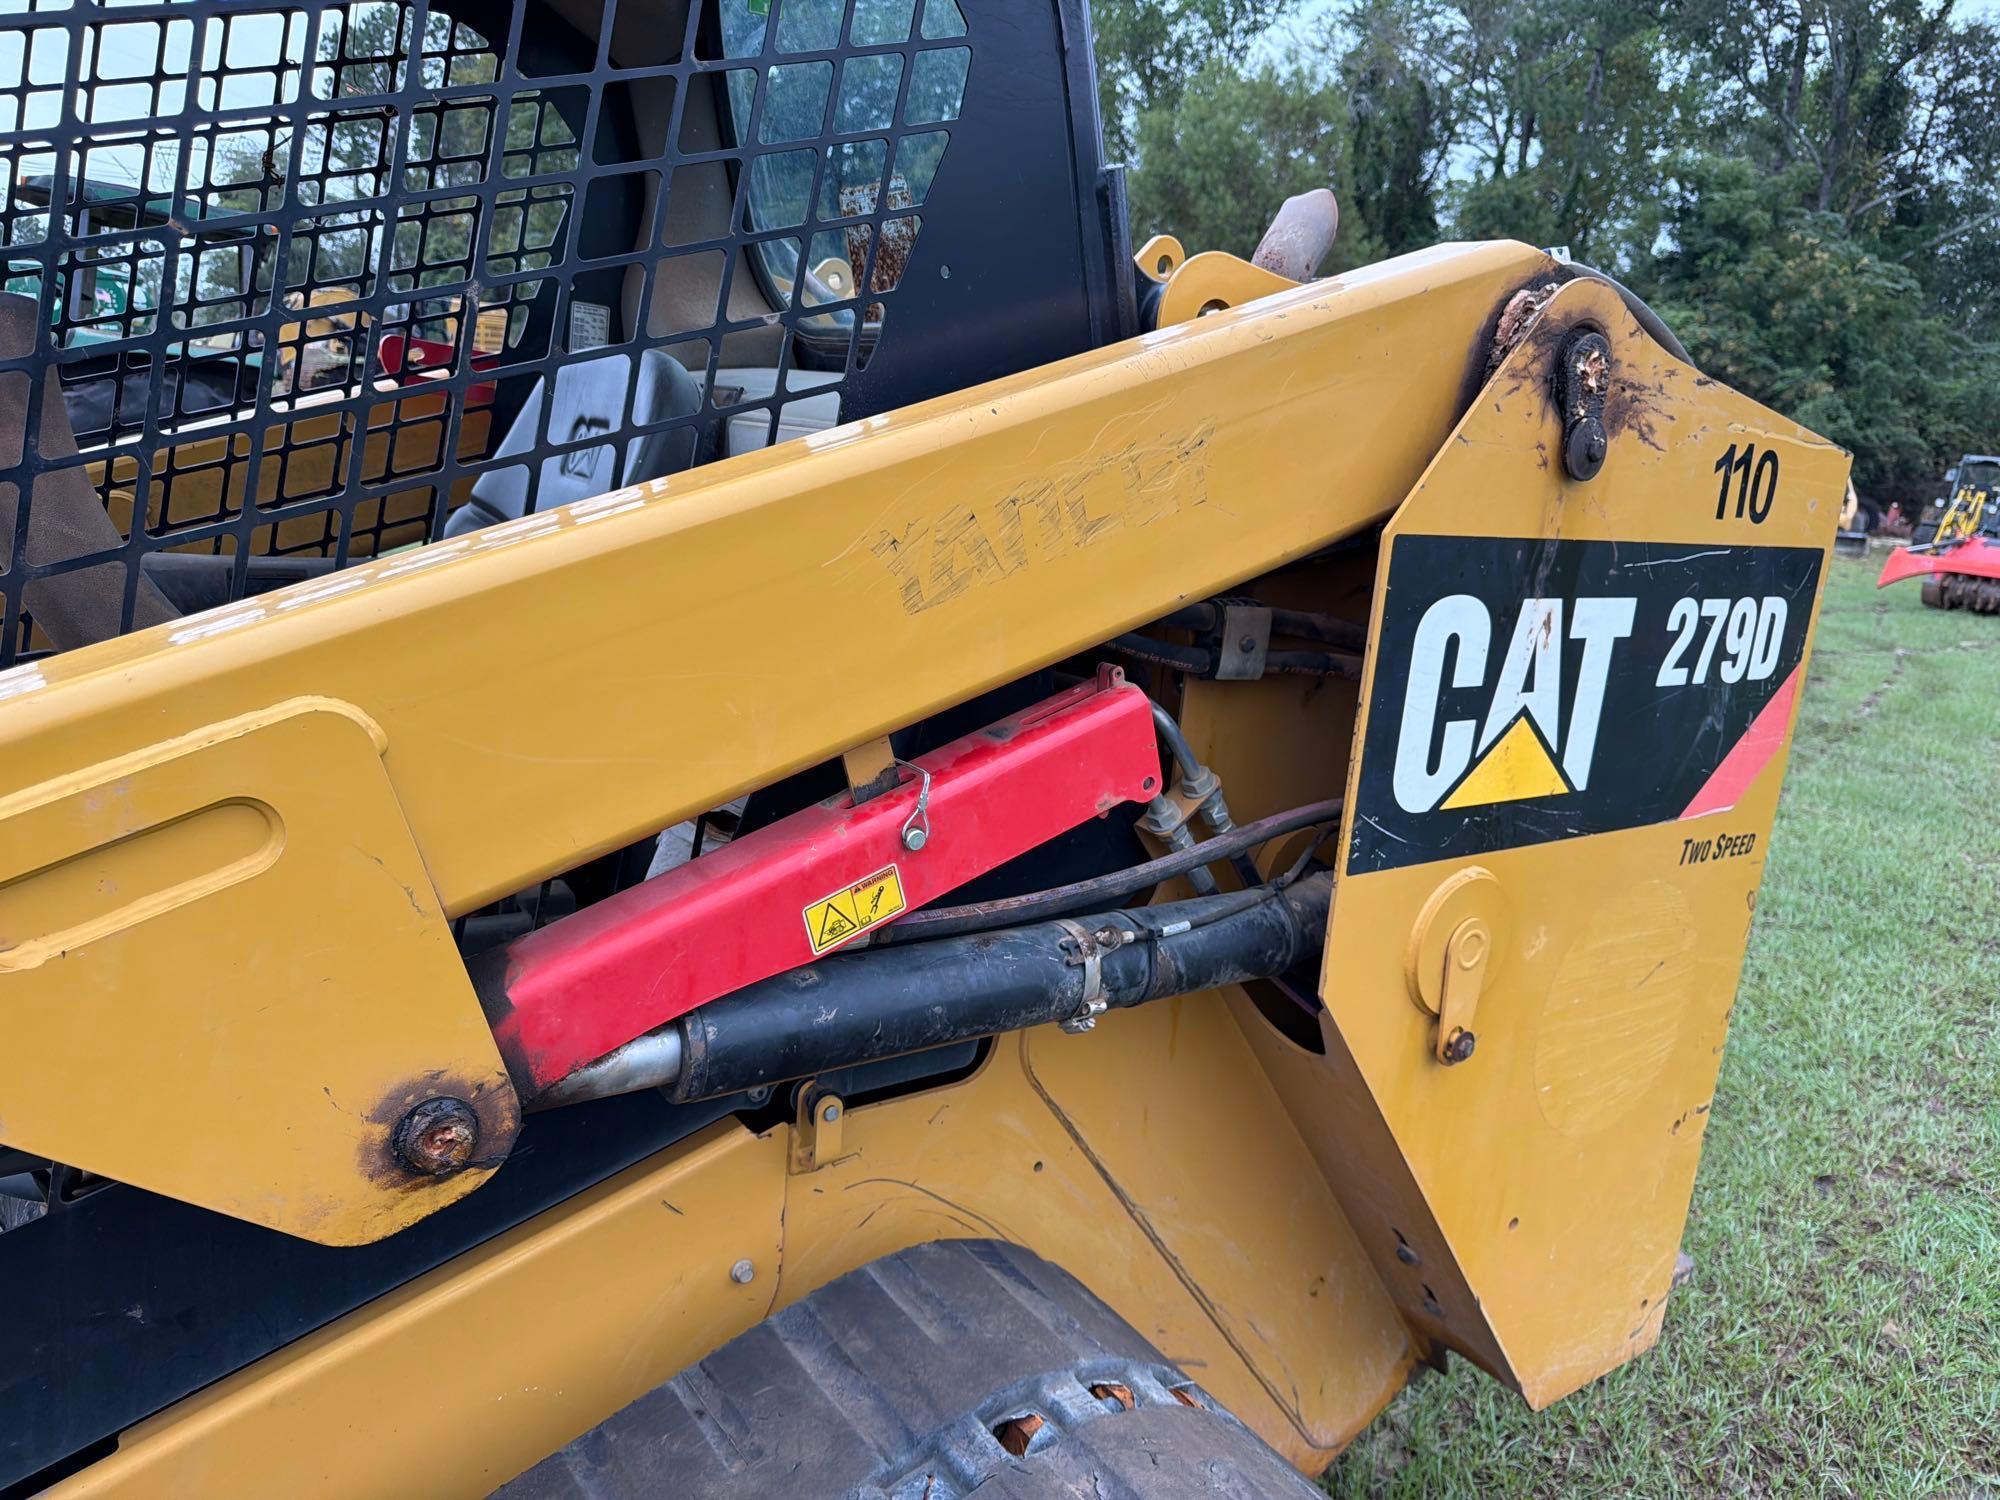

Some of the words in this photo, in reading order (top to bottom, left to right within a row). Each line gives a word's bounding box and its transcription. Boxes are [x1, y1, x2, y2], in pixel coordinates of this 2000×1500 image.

[1714, 443, 1779, 524] 110
[1656, 596, 1788, 687] 279D
[1393, 594, 1638, 814] CAT
[861, 869, 894, 889] WARNING
